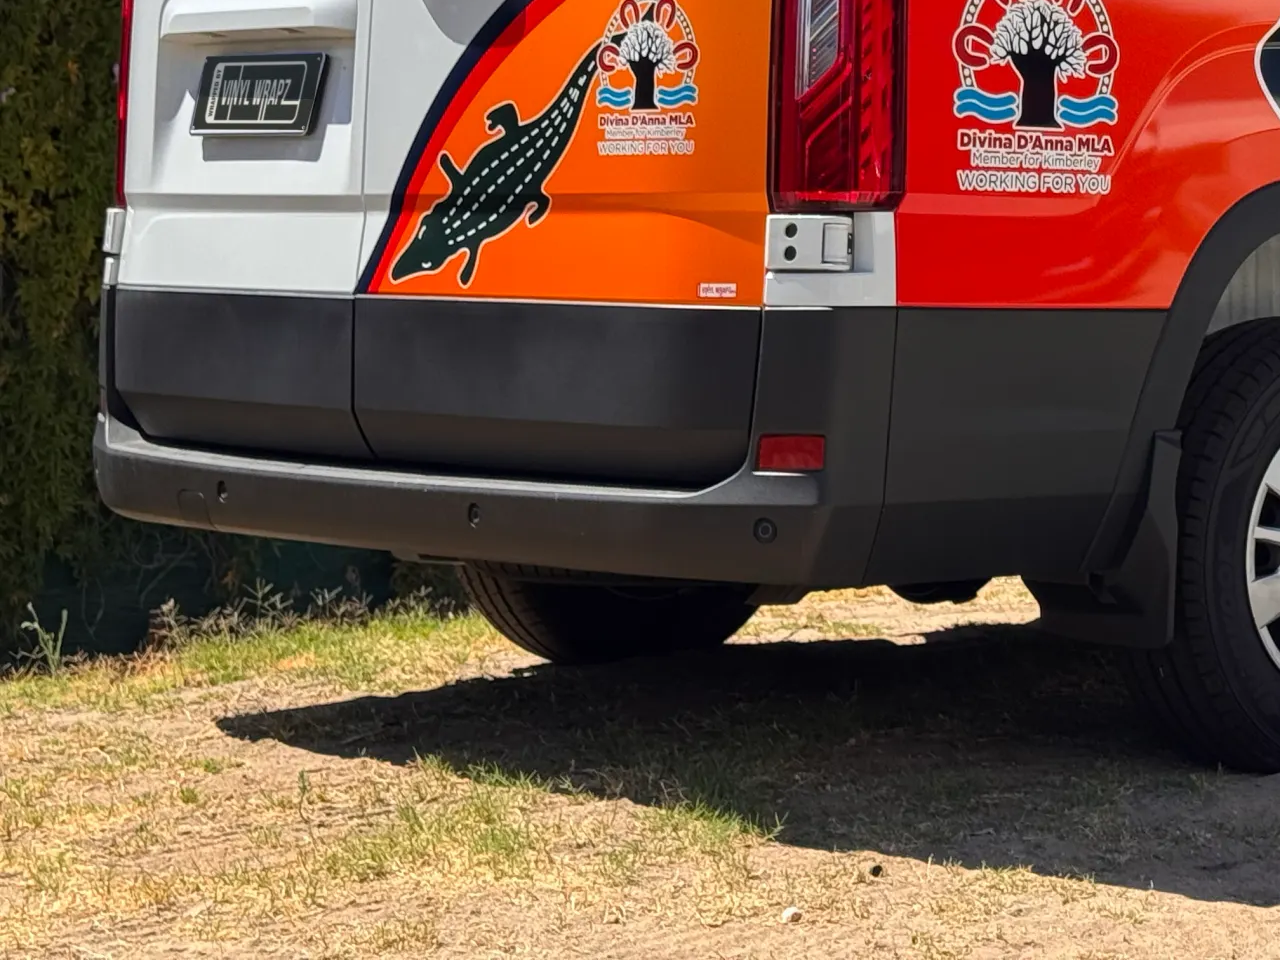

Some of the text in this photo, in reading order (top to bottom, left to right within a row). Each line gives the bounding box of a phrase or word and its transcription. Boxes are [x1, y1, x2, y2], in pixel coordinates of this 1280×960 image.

[207, 81, 220, 118] WRAPPED
[221, 78, 294, 107] VINYL WRAPZ
[599, 114, 694, 127] Divina D'Anna MLA
[606, 128, 634, 138] Member
[647, 127, 684, 139] Kimberley
[959, 131, 1112, 154] Divina D'Anna MLA
[599, 141, 694, 154] WORKING FOR YOU
[972, 152, 1100, 171] Member for Kimberley
[958, 172, 1111, 192] WORKING FOR YOU
